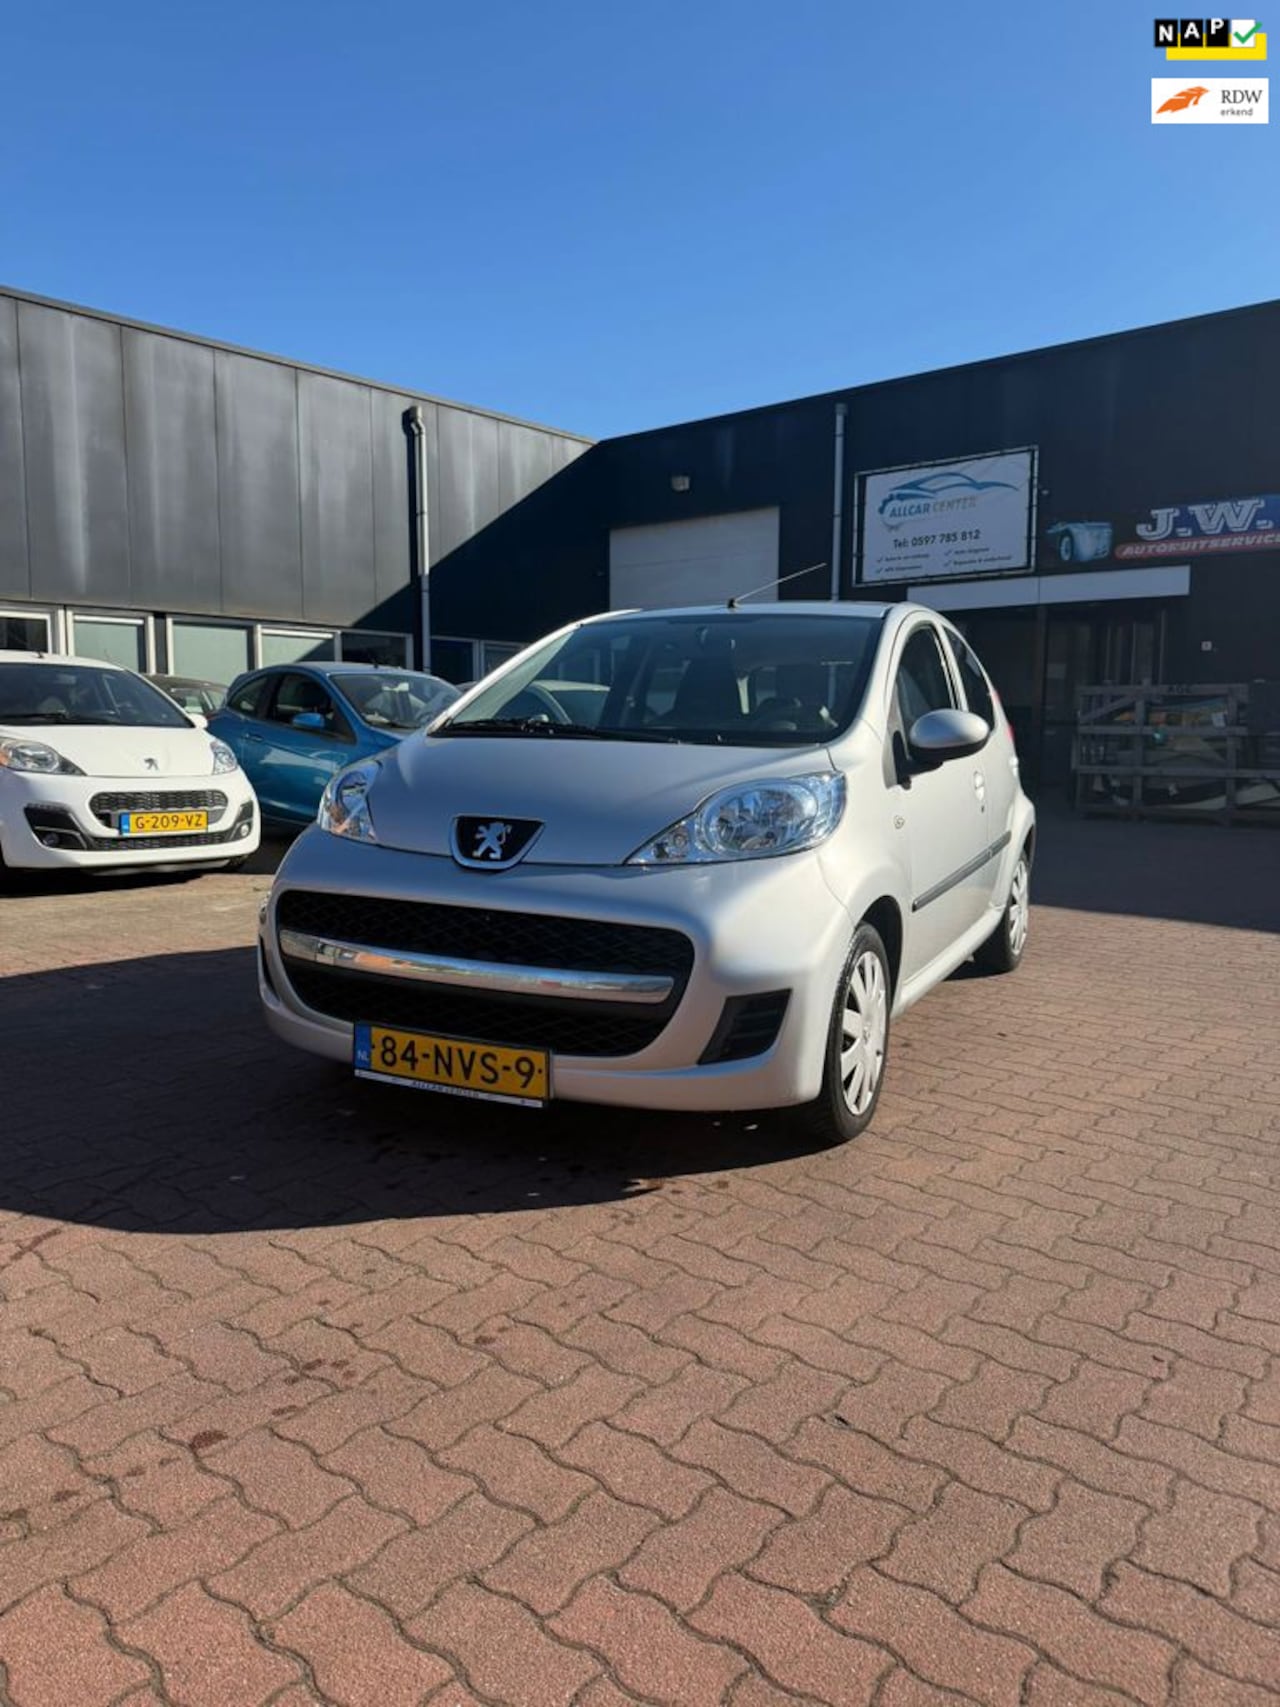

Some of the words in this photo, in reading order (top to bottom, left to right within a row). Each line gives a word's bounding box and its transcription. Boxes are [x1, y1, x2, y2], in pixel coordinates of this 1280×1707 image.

[889, 502, 930, 518] ALLCAR
[1136, 498, 1275, 541] J.W.
[911, 535, 936, 547] 0597
[961, 529, 981, 541] 812
[135, 813, 202, 829] G-209-VZ
[357, 1050, 369, 1061] NL
[380, 1036, 536, 1089] 84-NVS-9
